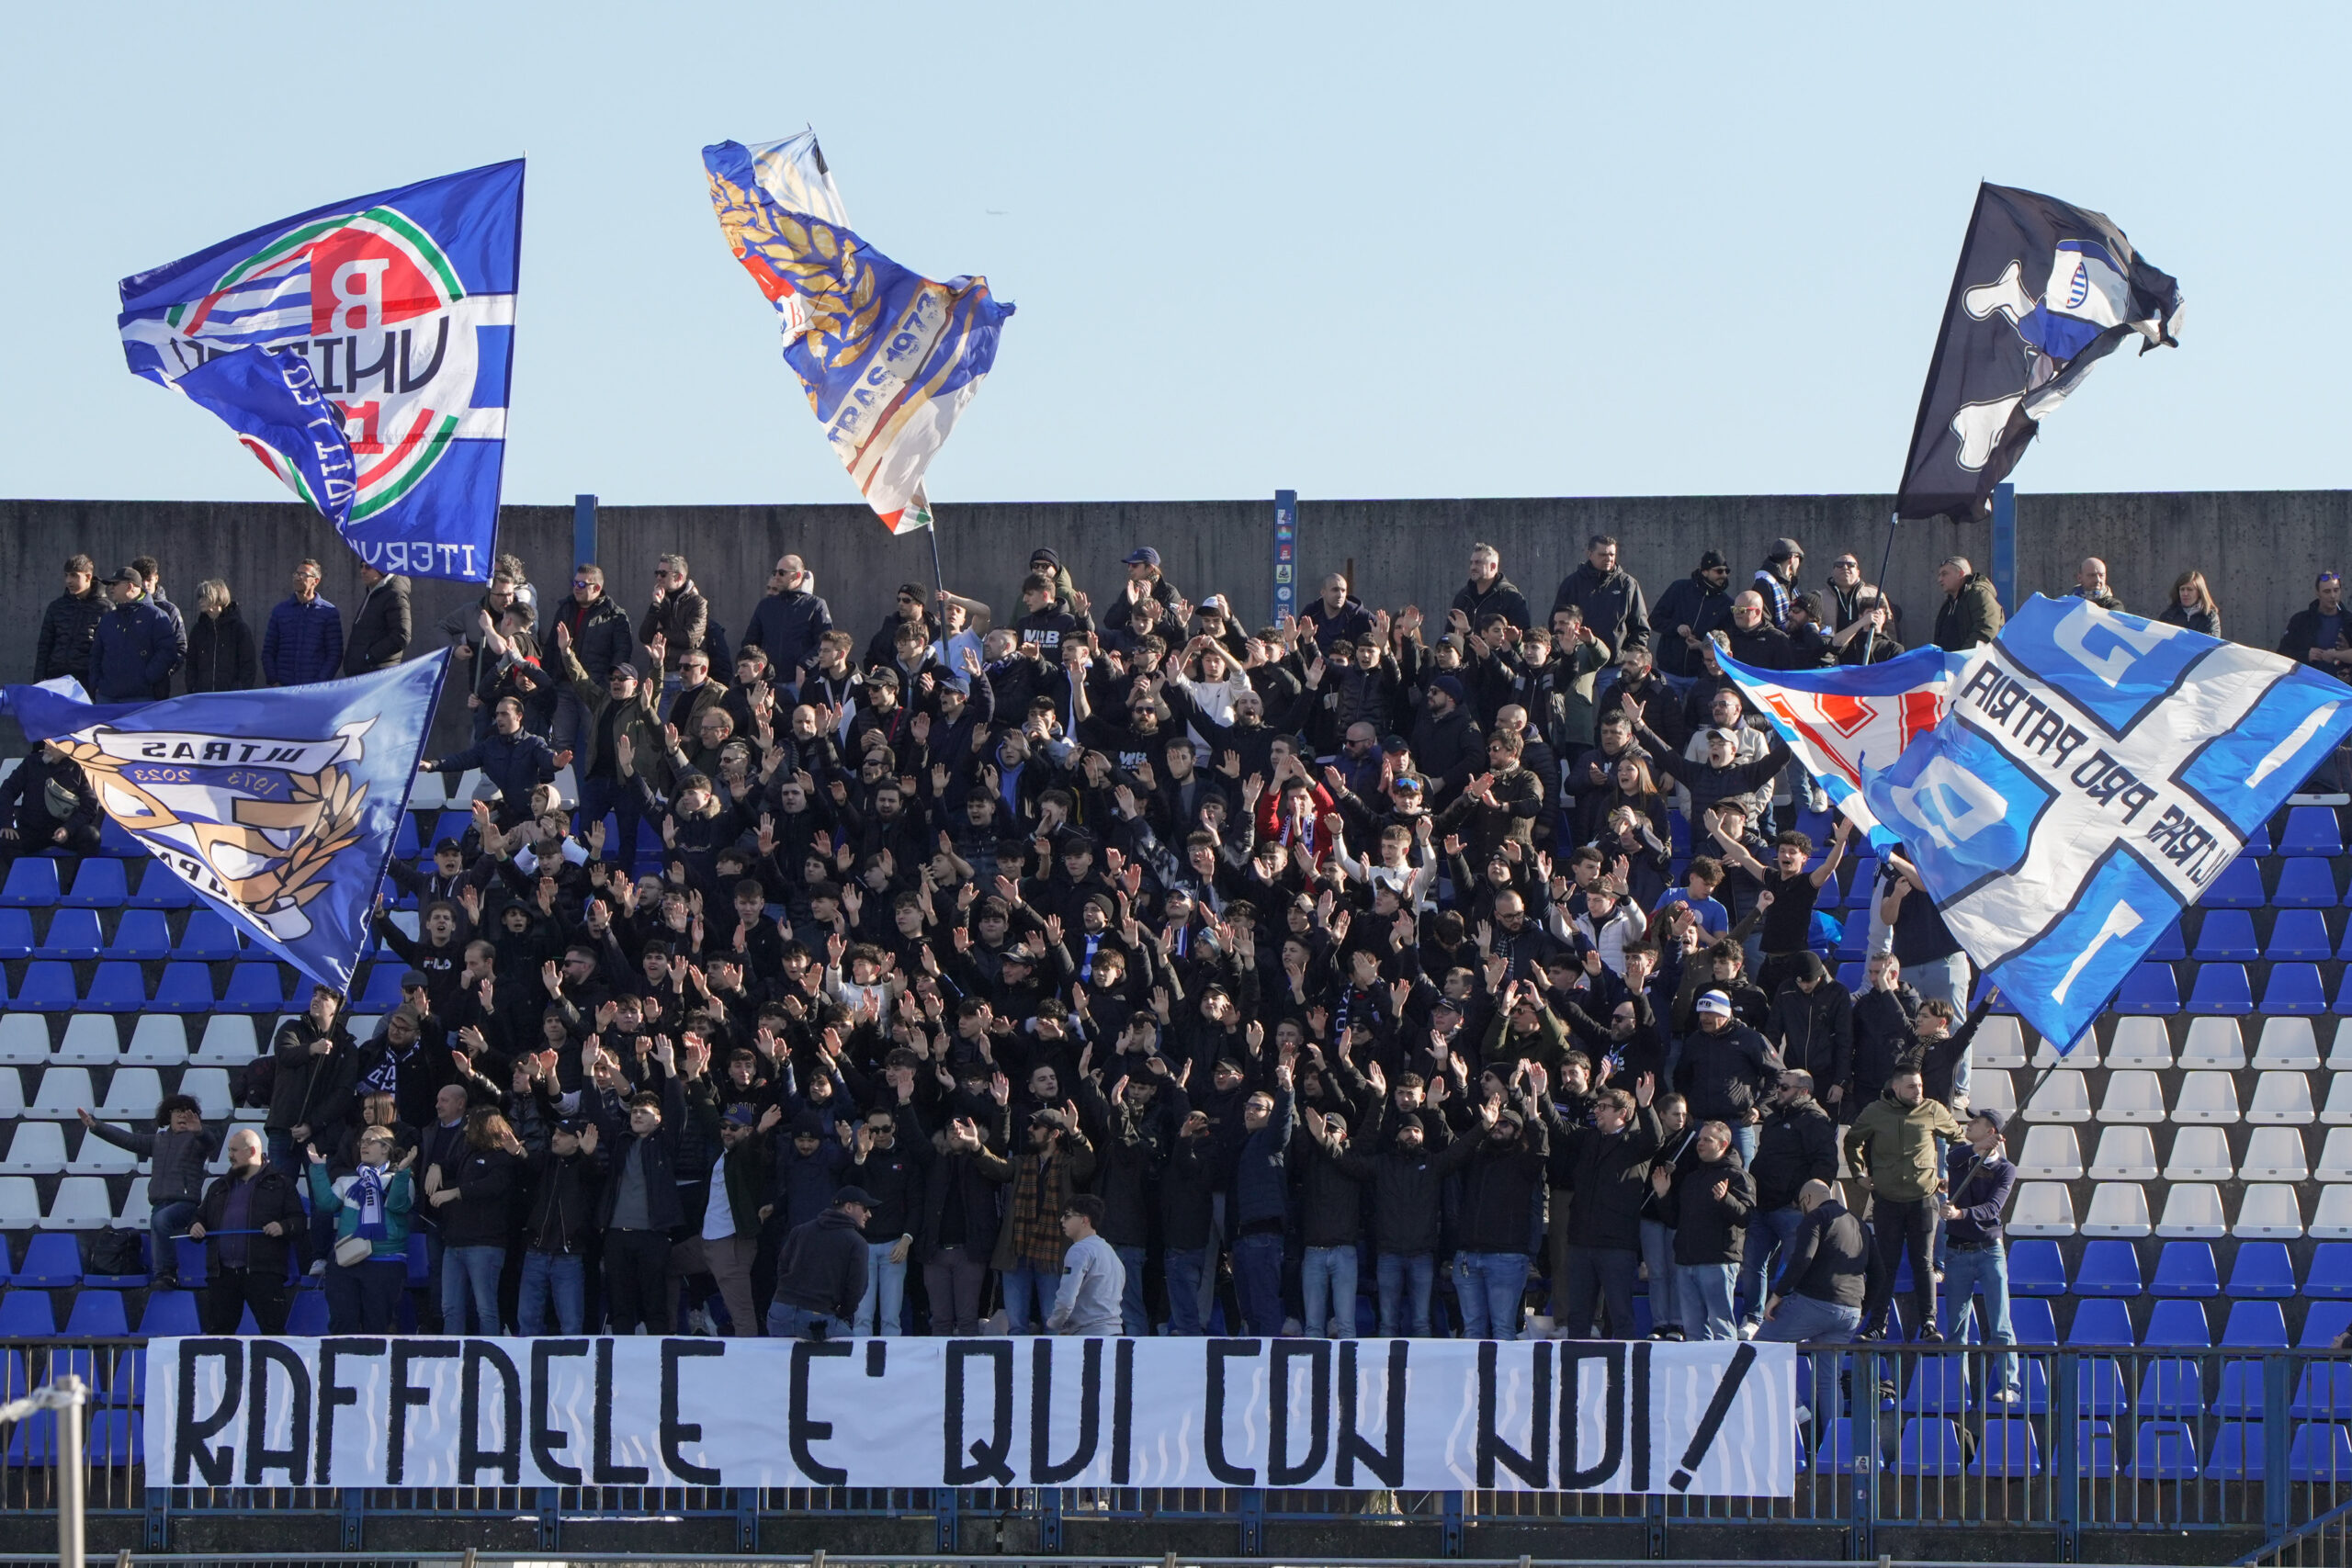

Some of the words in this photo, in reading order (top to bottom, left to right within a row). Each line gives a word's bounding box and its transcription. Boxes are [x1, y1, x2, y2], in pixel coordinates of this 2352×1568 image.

[827, 366, 896, 446] TRAS
[886, 292, 938, 365] 1973
[423, 956, 452, 970] FILA
[173, 1337, 726, 1486] RAFFAELE
[789, 1340, 888, 1486] E'
[943, 1338, 1136, 1487] QUI
[1204, 1338, 1409, 1488] CON
